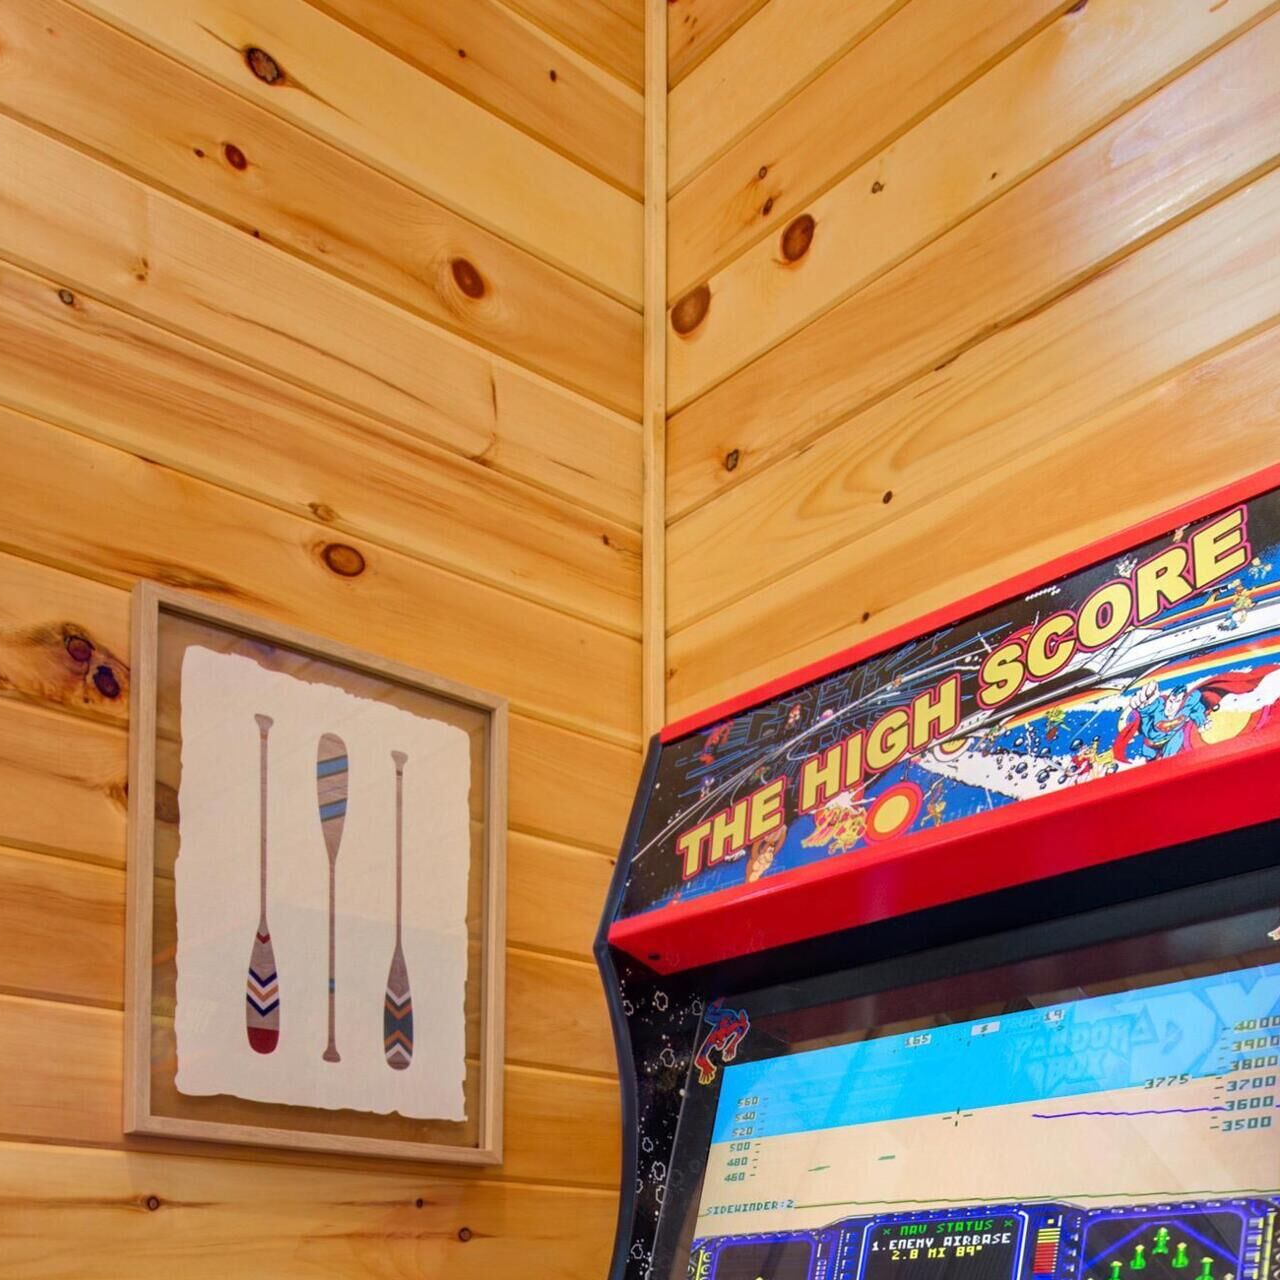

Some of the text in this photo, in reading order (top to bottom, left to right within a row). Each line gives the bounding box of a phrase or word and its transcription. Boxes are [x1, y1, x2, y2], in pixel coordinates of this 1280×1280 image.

[677, 506, 1250, 879] THE HIGH SCORE
[1232, 1035, 1280, 1052] 3900
[1230, 1055, 1279, 1072] 3800
[1143, 1074, 1190, 1090] 3775
[1226, 1075, 1277, 1092] 3700
[1224, 1095, 1275, 1112] 3600
[1221, 1116, 1272, 1132] 3500
[729, 1141, 751, 1152] 500
[707, 1199, 795, 1216] SIDEWINDER:2
[899, 1219, 995, 1236] NAV STATUS
[871, 1232, 1012, 1252] 1.ENEMY AIRBASE
[891, 1248, 919, 1261] 2.8
[927, 1247, 946, 1259] MI
